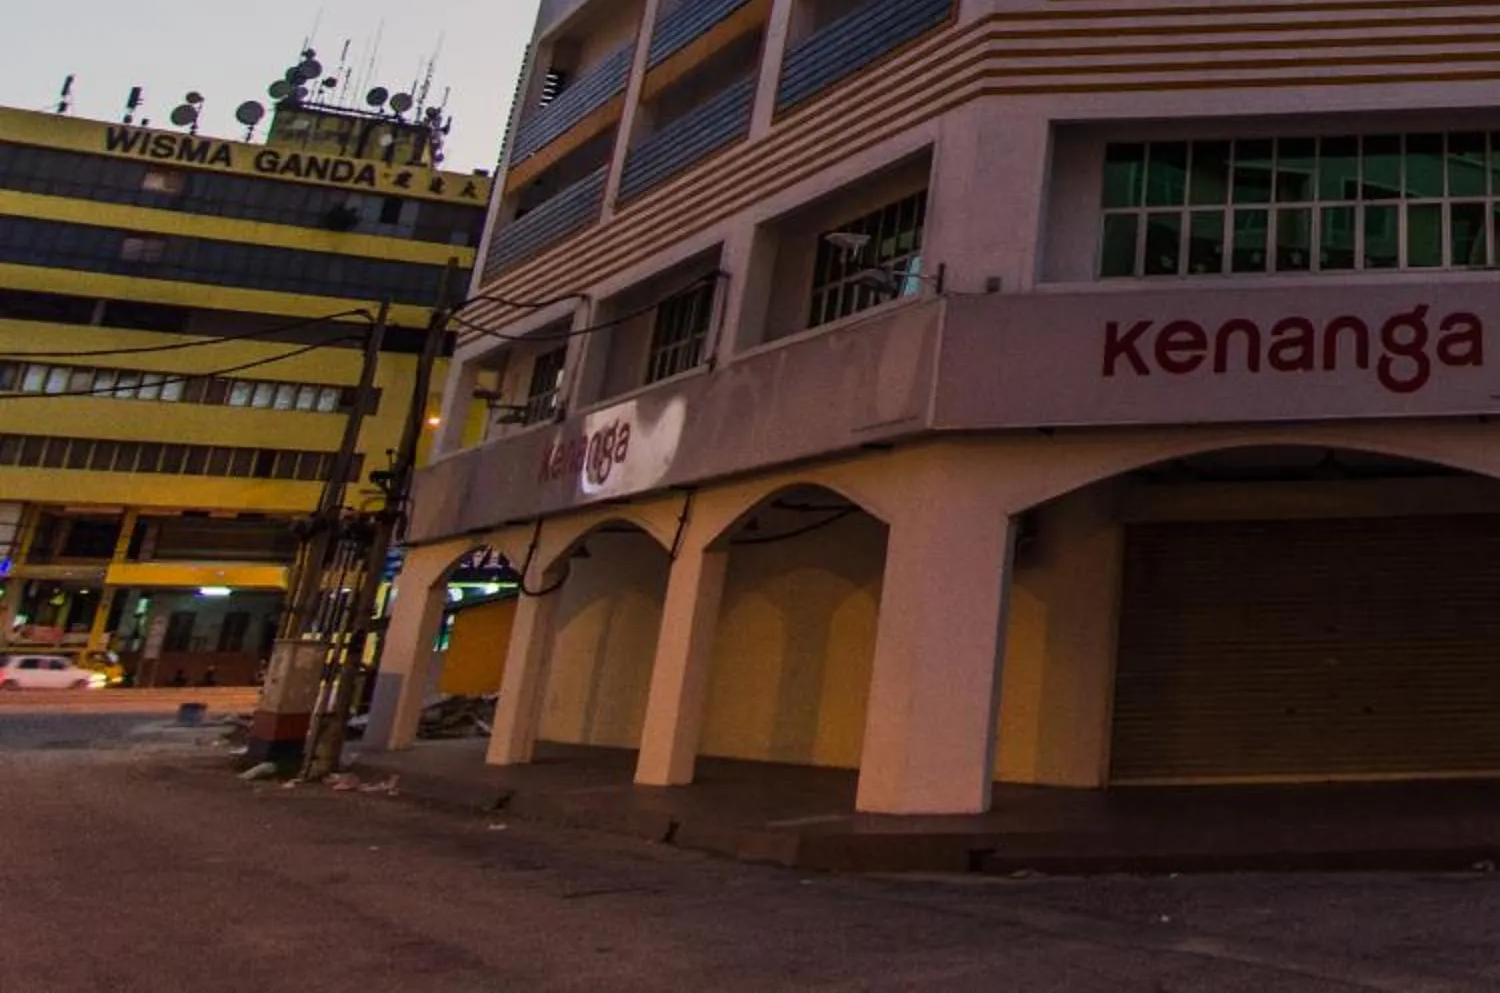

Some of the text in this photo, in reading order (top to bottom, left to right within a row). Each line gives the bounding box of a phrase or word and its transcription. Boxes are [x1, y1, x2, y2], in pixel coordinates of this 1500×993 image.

[106, 125, 232, 168] WISMA
[254, 150, 376, 187] GANDA
[1102, 304, 1484, 394] Kenanga
